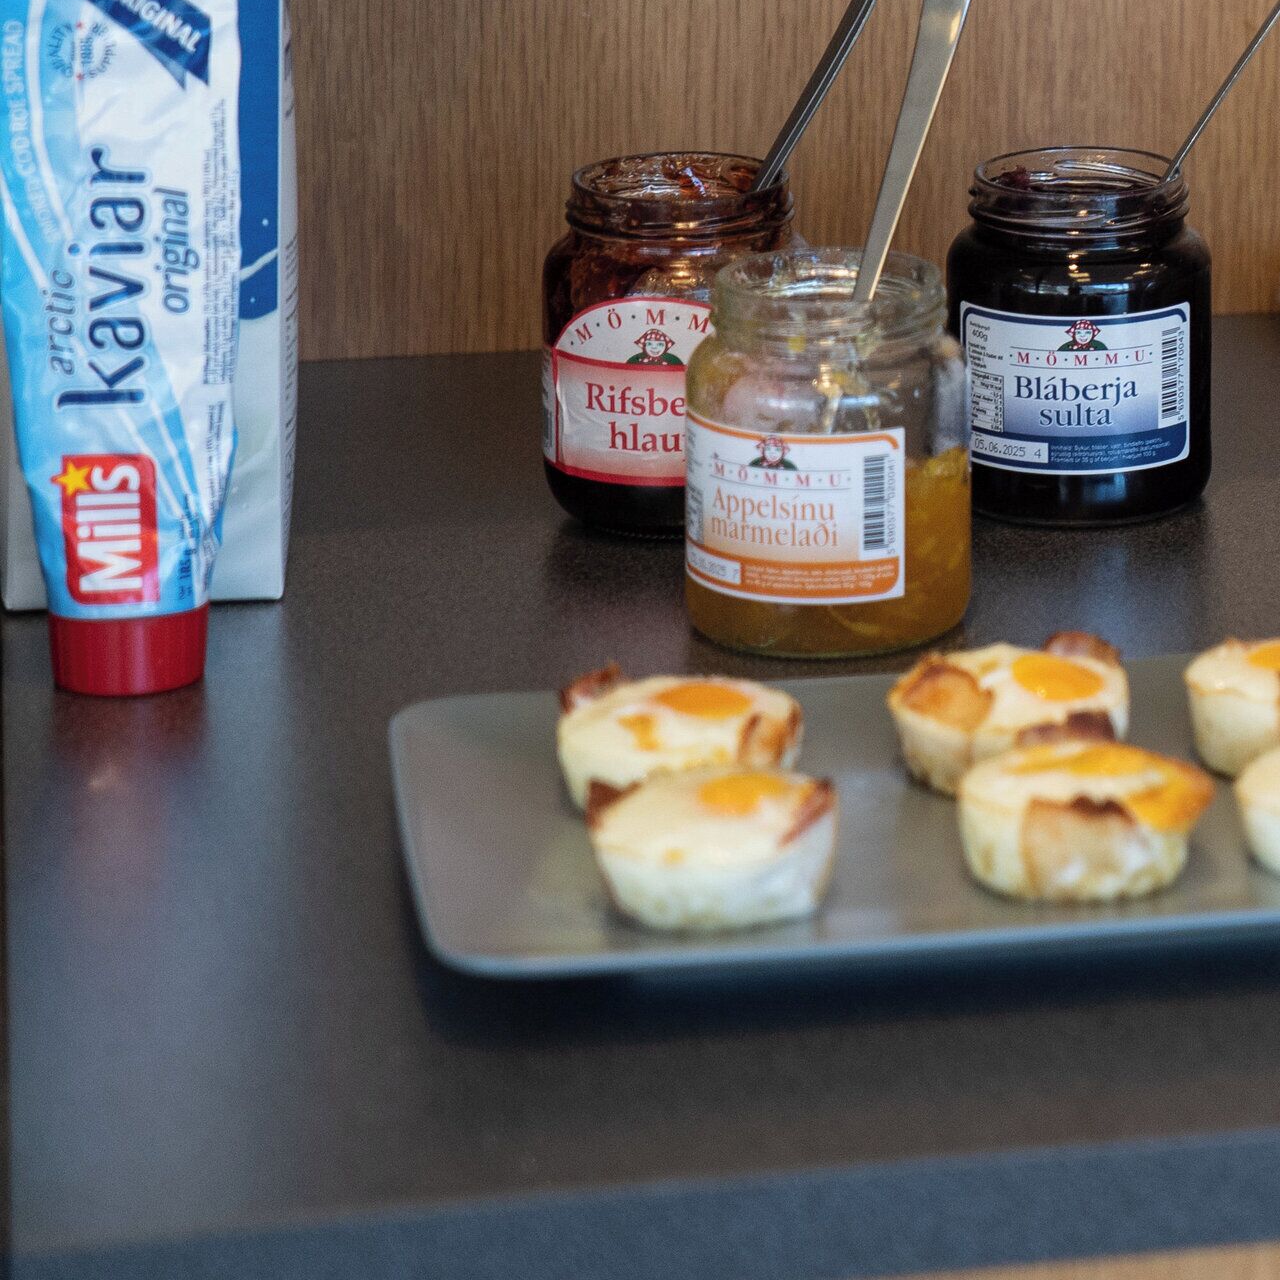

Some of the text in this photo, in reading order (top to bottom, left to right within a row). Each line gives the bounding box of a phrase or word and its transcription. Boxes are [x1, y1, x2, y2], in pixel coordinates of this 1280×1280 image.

[4, 20, 25, 95] SPREAD
[12, 136, 36, 177] COD
[152, 187, 200, 314] original
[57, 147, 145, 407] kaviar
[42, 270, 75, 375] arctic
[585, 381, 686, 417] Rifsbe
[1014, 375, 1138, 407] Bláberja
[1039, 403, 1113, 427] sulta
[608, 421, 686, 461] hlau
[974, 440, 1027, 458] 05.06.2025
[1034, 449, 1042, 459] 4
[712, 485, 835, 521] Appelsínu
[76, 465, 142, 593] Mills
[711, 514, 838, 547] marmelaði
